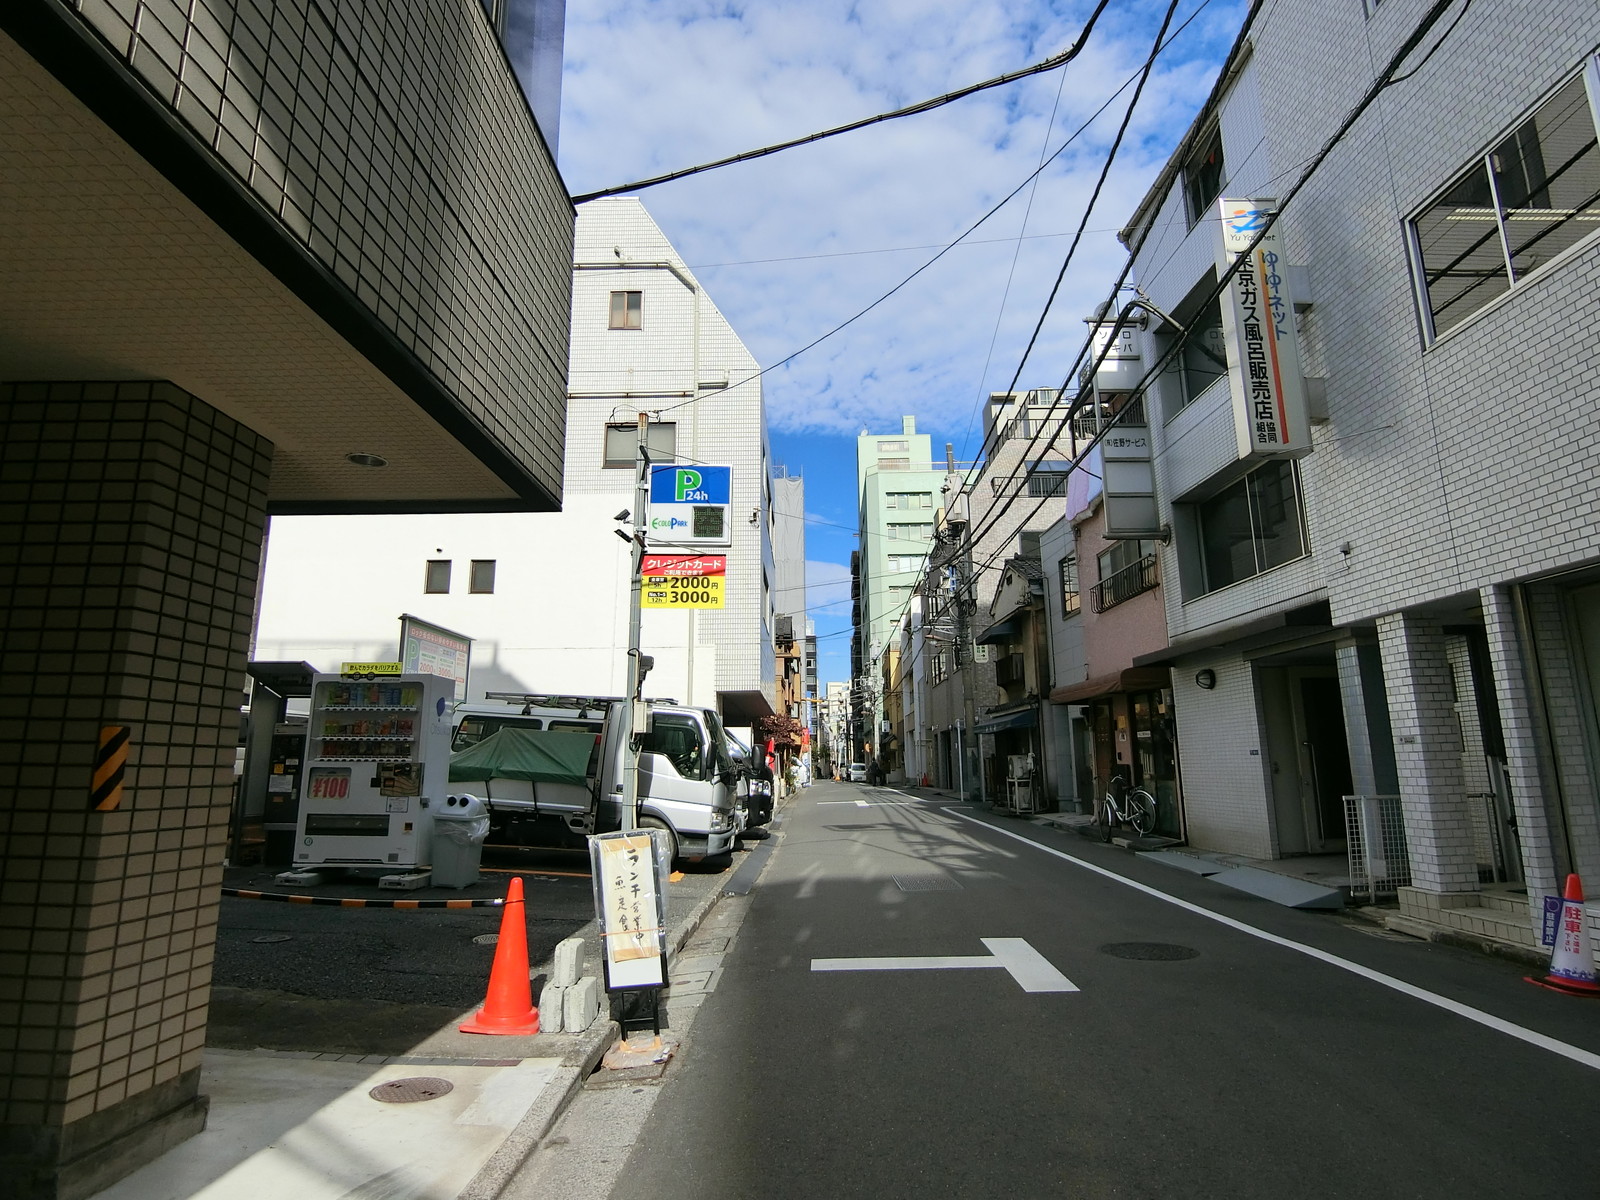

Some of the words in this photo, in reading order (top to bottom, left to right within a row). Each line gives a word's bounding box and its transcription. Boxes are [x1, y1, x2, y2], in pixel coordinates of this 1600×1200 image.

[675, 469, 702, 501] P
[686, 491, 708, 500] 24h
[647, 559, 722, 569] クレジットカード
